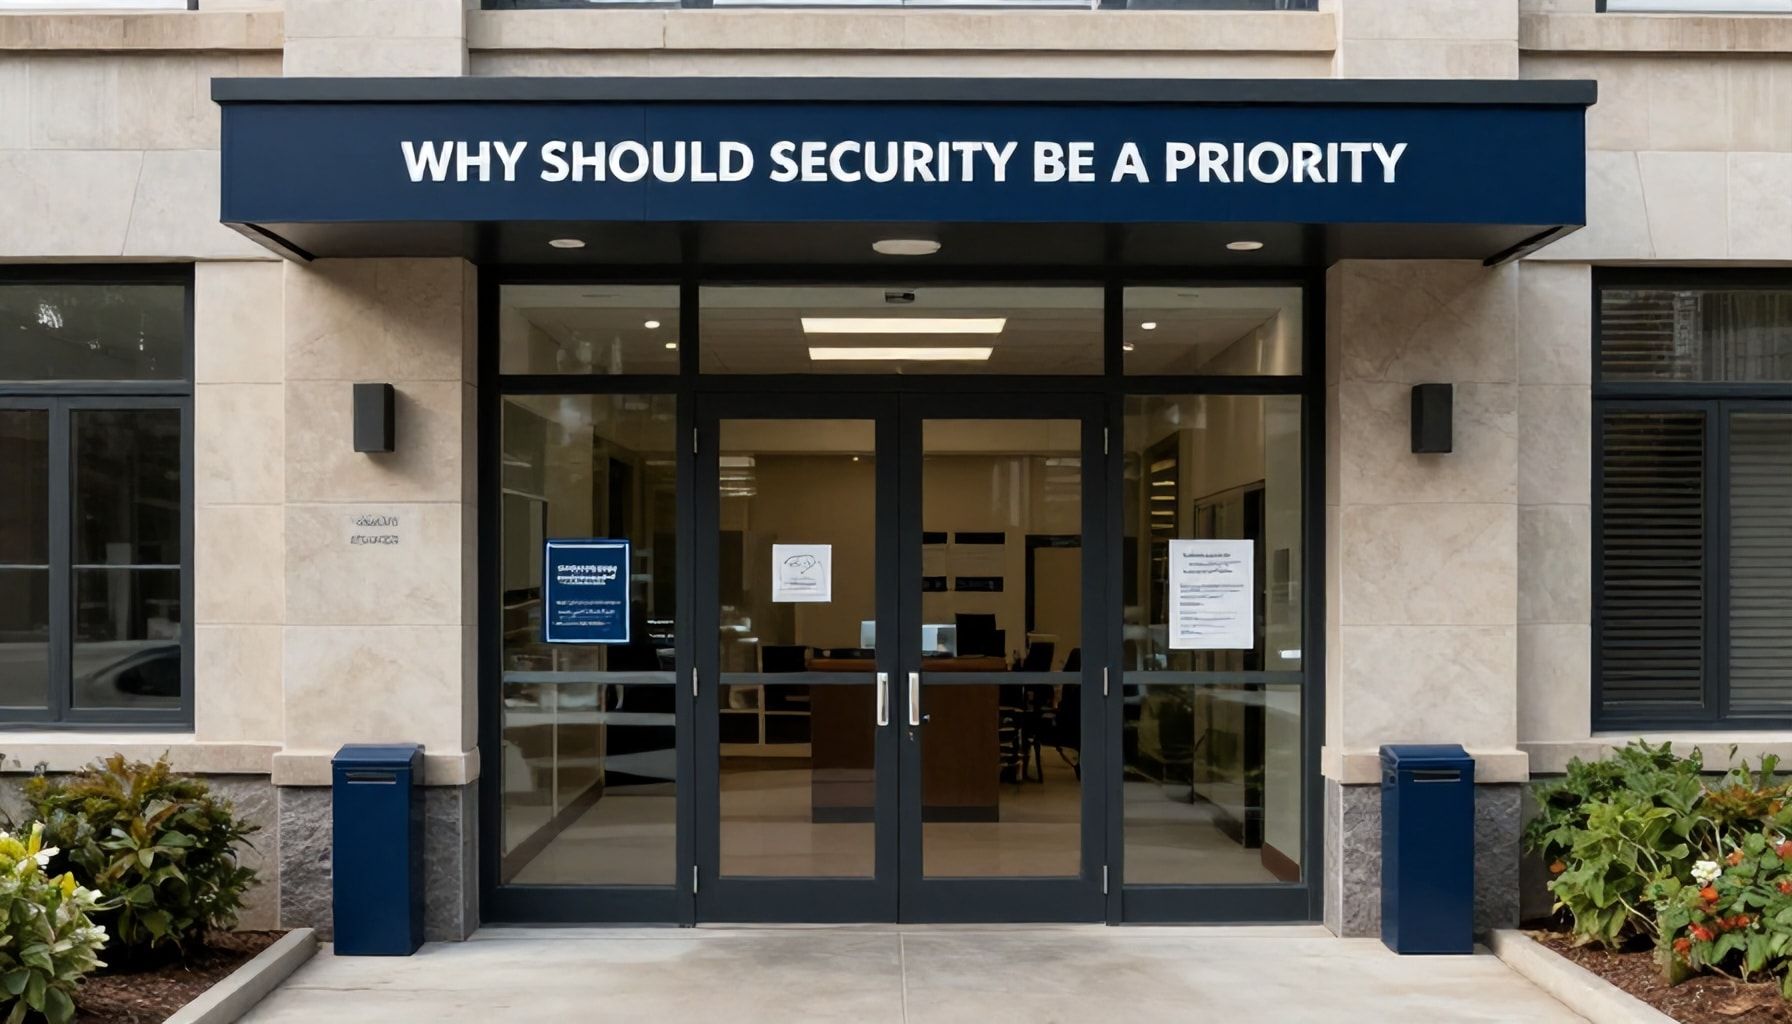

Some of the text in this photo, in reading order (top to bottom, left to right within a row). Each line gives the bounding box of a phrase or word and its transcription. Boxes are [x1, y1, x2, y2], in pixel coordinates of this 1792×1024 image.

[401, 141, 1408, 183] WHY SHOULD SECURITY BE A PRIORITY
